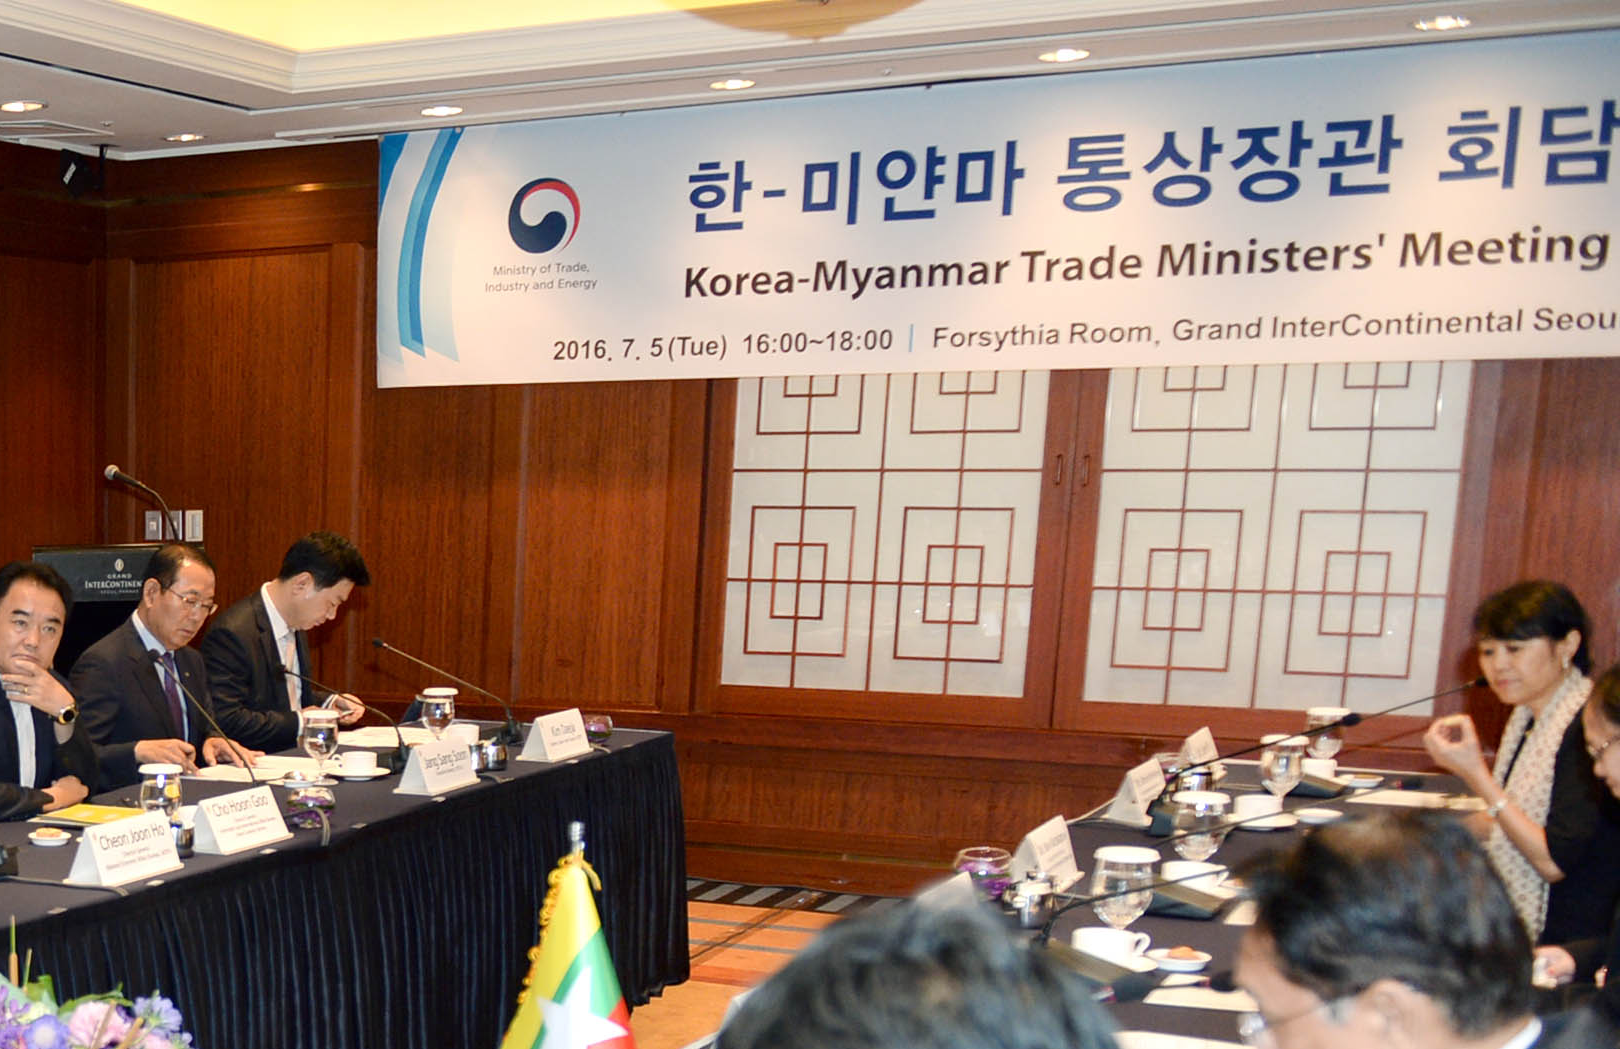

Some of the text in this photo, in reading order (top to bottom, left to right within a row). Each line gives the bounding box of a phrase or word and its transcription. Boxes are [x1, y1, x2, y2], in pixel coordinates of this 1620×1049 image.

[688, 99, 1620, 233] 한-미얀마 통상장관 회담
[492, 262, 590, 277] Ministry of Trade,
[684, 225, 1610, 299] Korea-Myanmar Trade Ministers' Meeting
[484, 278, 598, 293] Industry and Energy
[553, 338, 612, 362] 2016.
[743, 329, 894, 354] 16:00~18:00
[933, 307, 1620, 351] Forsythia Room, Grand InterContinental Seou
[151, 823, 165, 837] Ho
